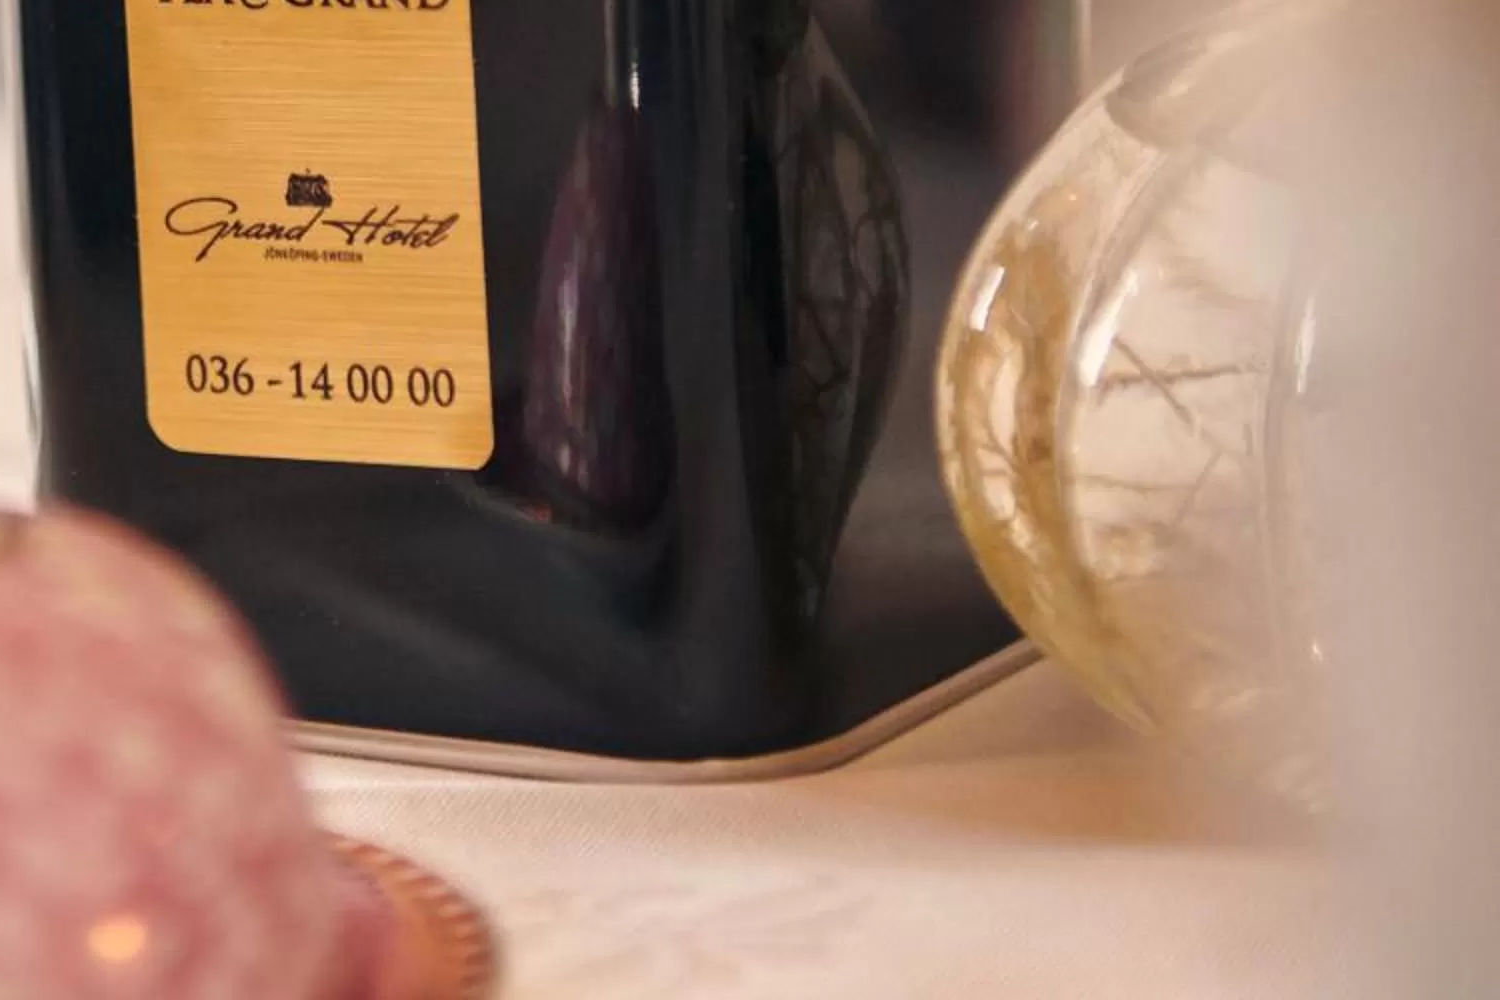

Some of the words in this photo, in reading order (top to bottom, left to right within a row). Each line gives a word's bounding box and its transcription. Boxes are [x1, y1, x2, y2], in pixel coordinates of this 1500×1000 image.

[165, 197, 324, 262] Grand
[322, 205, 460, 249] Hotel
[186, 354, 254, 396] 036
[346, 363, 394, 404] 00
[407, 366, 456, 407] 00
